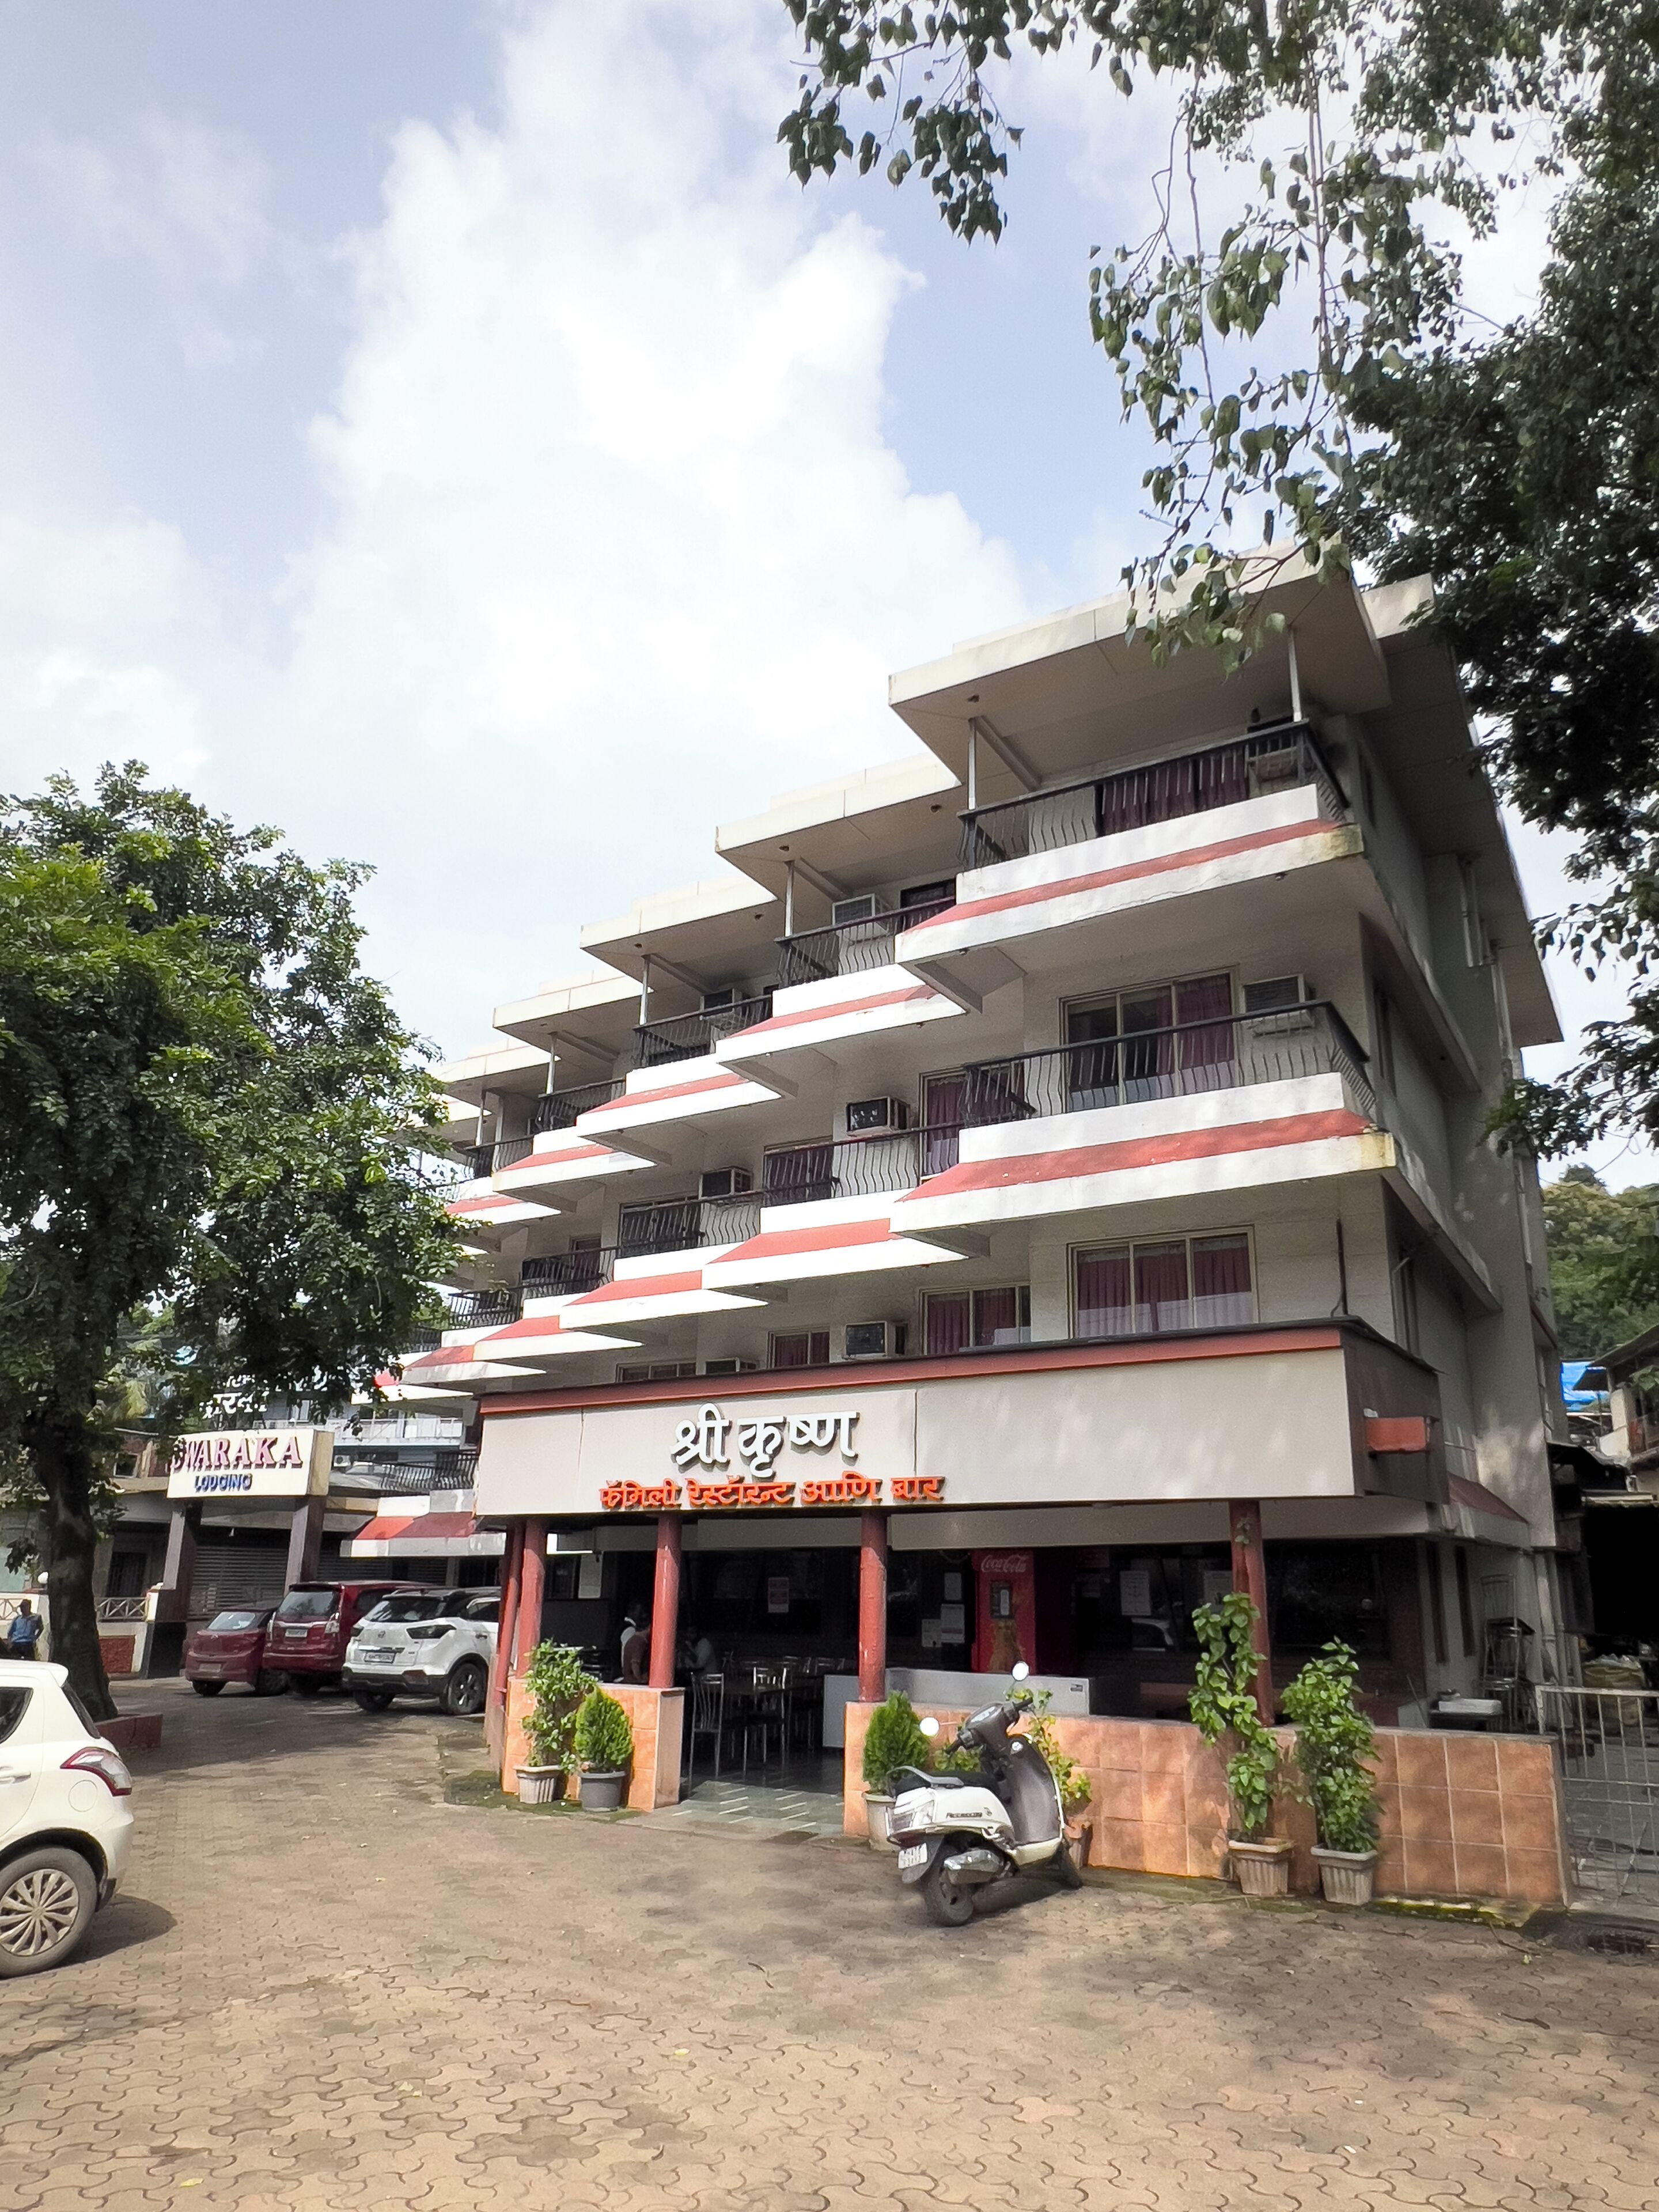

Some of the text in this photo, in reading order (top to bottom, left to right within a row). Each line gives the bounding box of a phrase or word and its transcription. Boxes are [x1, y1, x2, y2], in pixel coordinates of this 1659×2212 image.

[670, 1403, 859, 1478] श्री कृष्ण
[800, 1471, 883, 1503] आणि
[891, 1476, 945, 1501] बार
